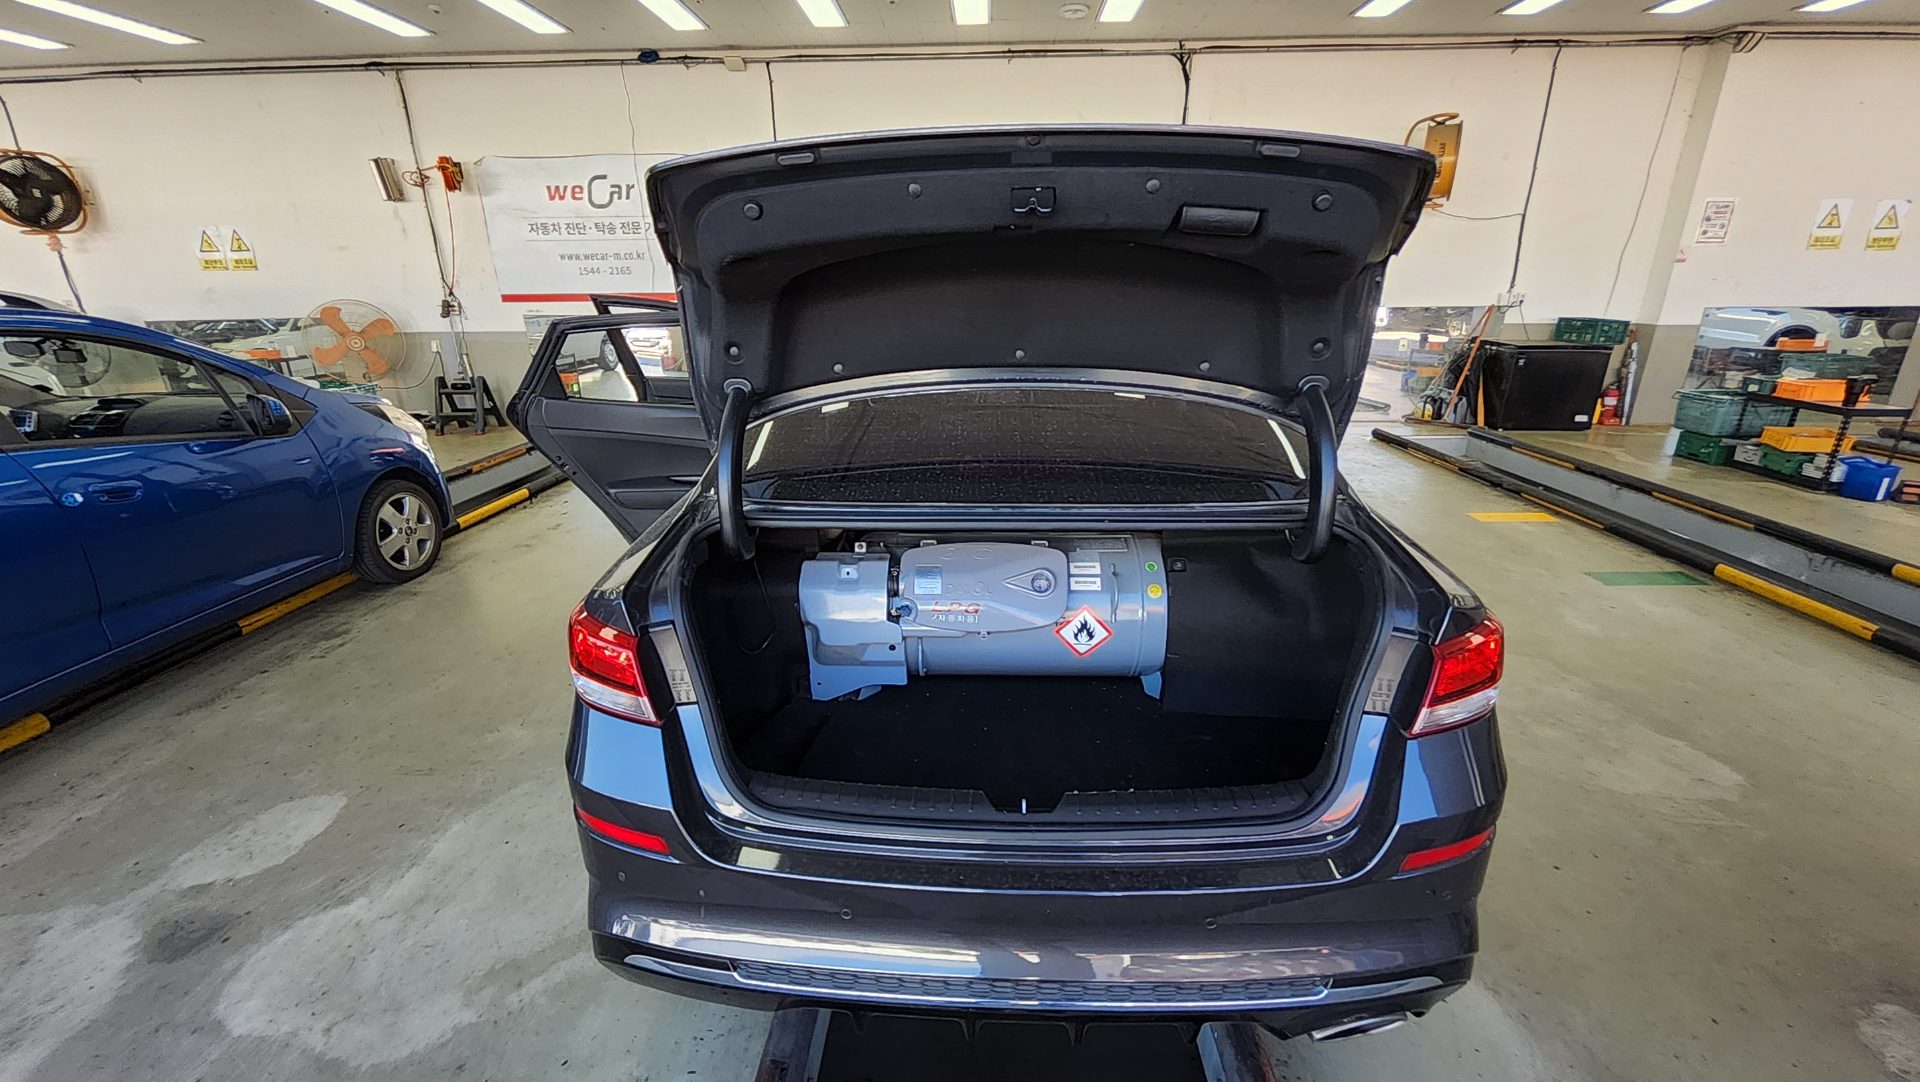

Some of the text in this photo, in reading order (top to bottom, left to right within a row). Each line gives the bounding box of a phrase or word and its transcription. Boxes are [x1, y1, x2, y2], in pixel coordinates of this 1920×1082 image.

[546, 174, 635, 209] weCar
[527, 222, 562, 236] 자동차
[619, 222, 643, 235] 전문
[559, 250, 645, 261] www.wecar-m.co.kr
[931, 601, 981, 614] LPG
